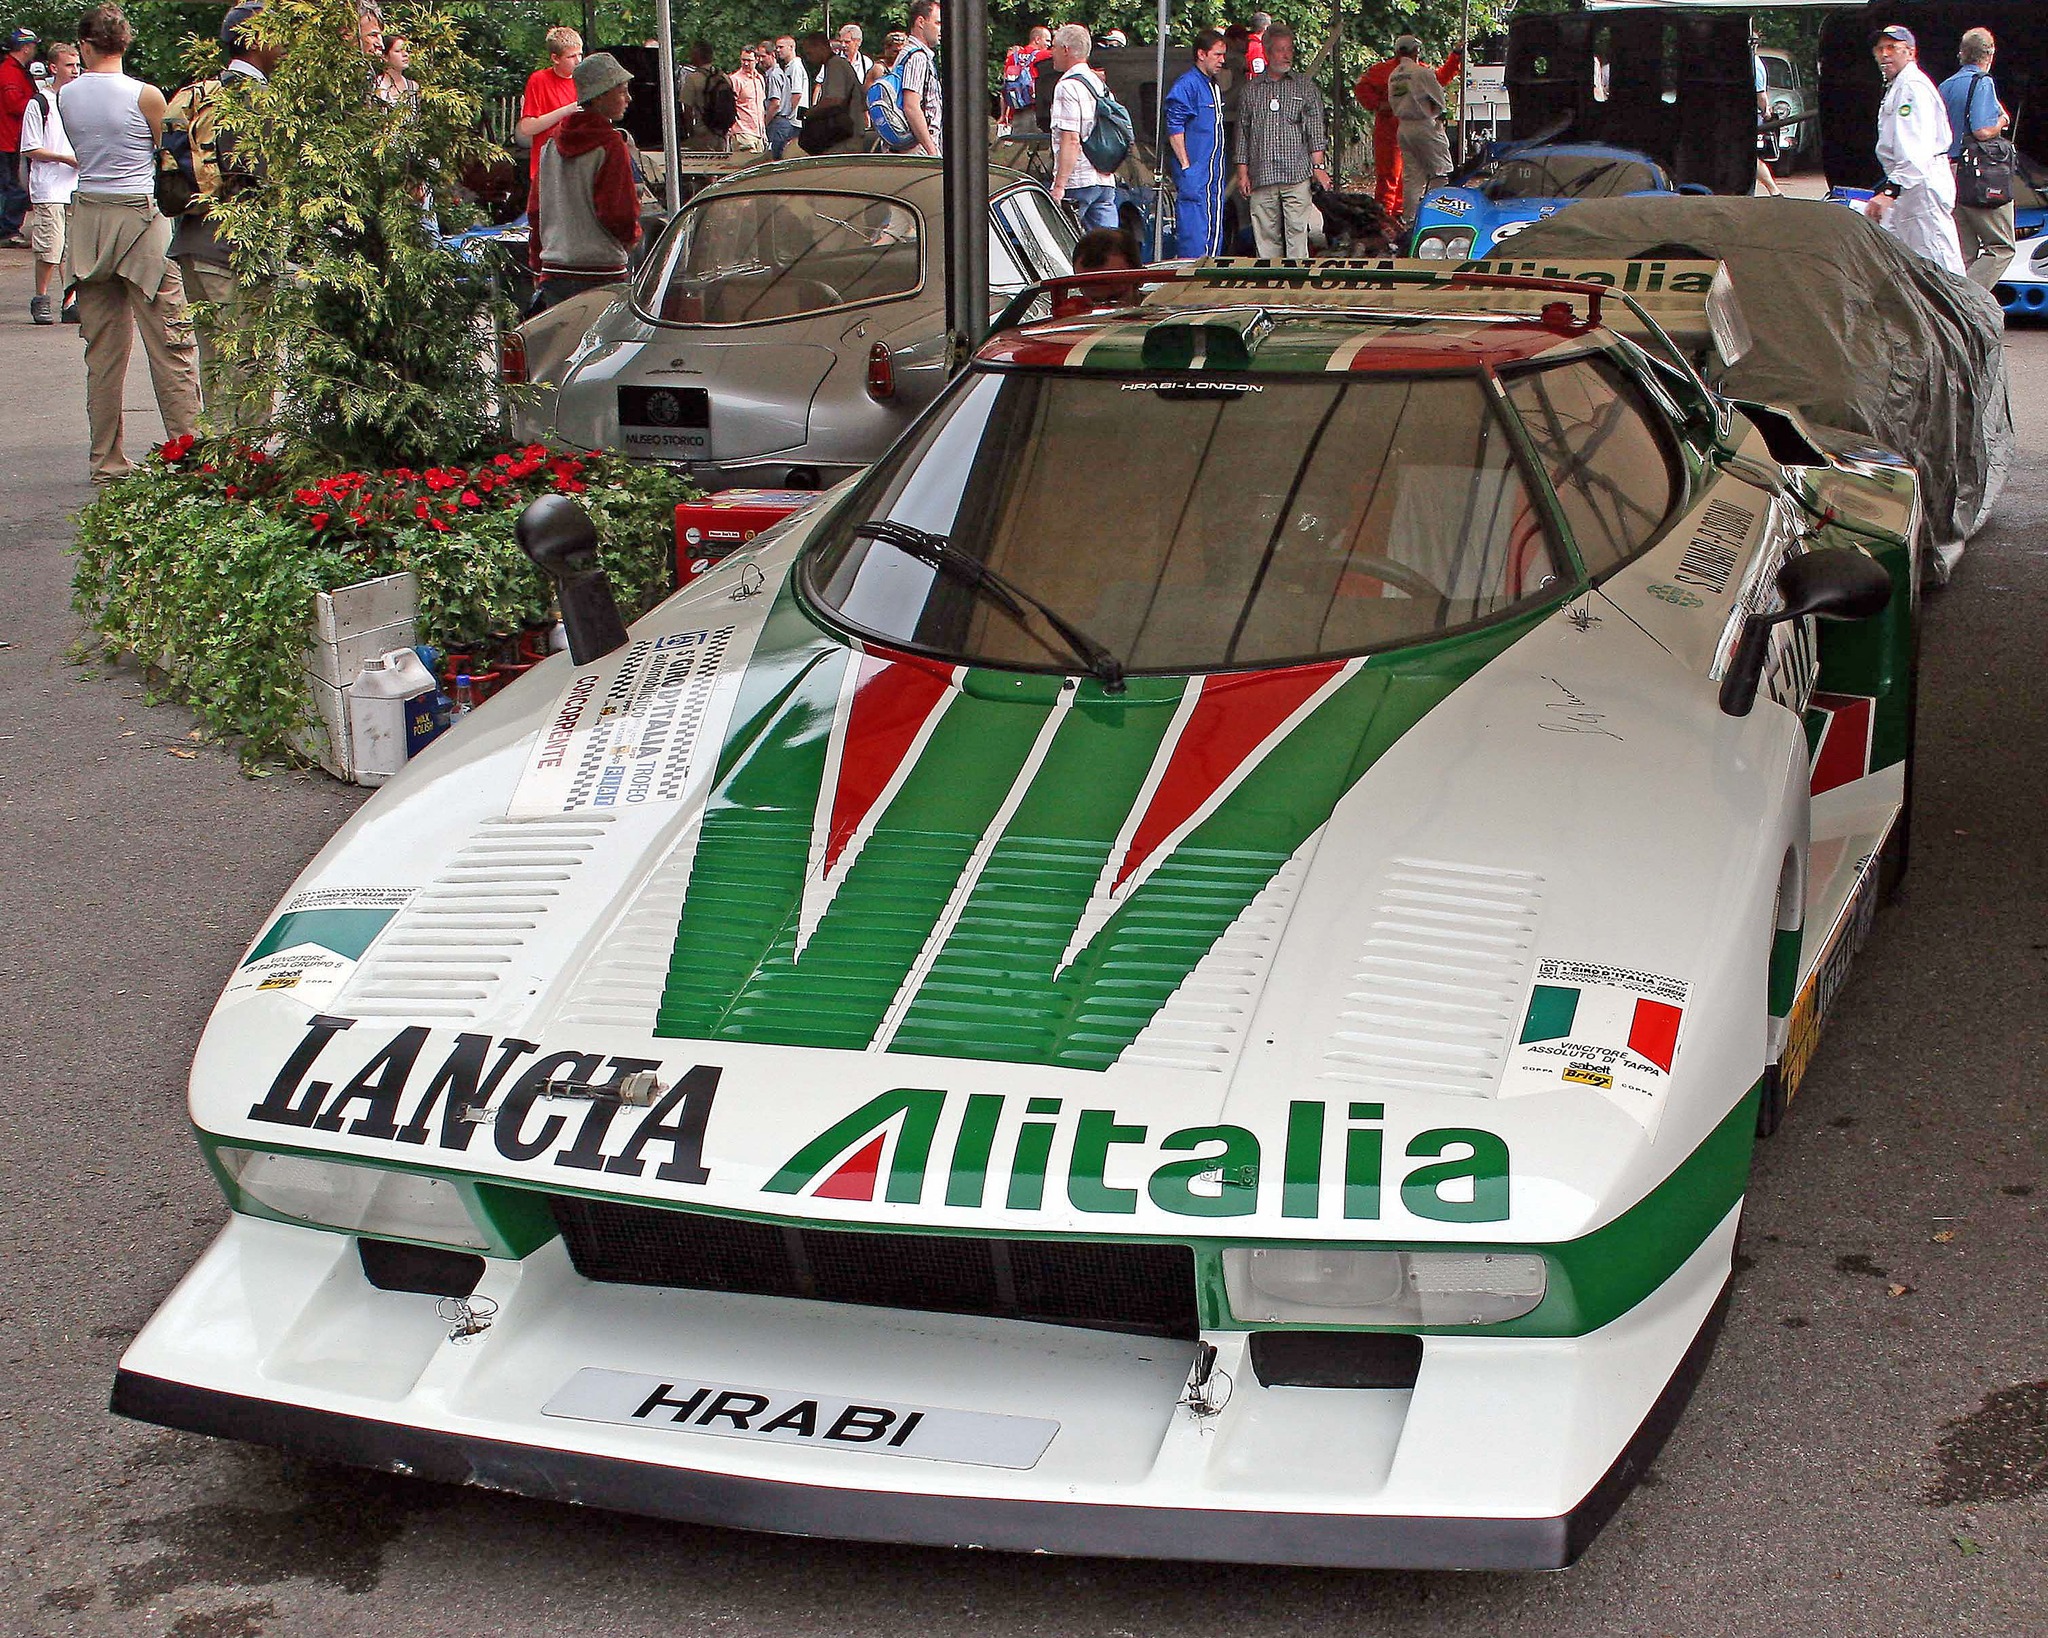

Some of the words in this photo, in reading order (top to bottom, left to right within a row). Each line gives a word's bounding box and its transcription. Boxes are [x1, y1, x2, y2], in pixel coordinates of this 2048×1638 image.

[626, 433, 661, 446] MUSEO
[663, 435, 704, 446] STORICO
[537, 675, 600, 770] CONCORRENTE
[626, 761, 657, 803] TROFEO
[1527, 1045, 1596, 1060] ASSOLUTO
[1602, 1055, 1616, 1065] DI
[1622, 1059, 1660, 1077] TAPPA
[1560, 1041, 1629, 1060] VINCITORE
[1564, 1069, 1611, 1087] Britax
[1568, 1060, 1611, 1075] sabelt
[246, 1014, 723, 1186] LANCIA
[759, 1087, 1511, 1224] Alitalia
[630, 1382, 926, 1448] HRABI
